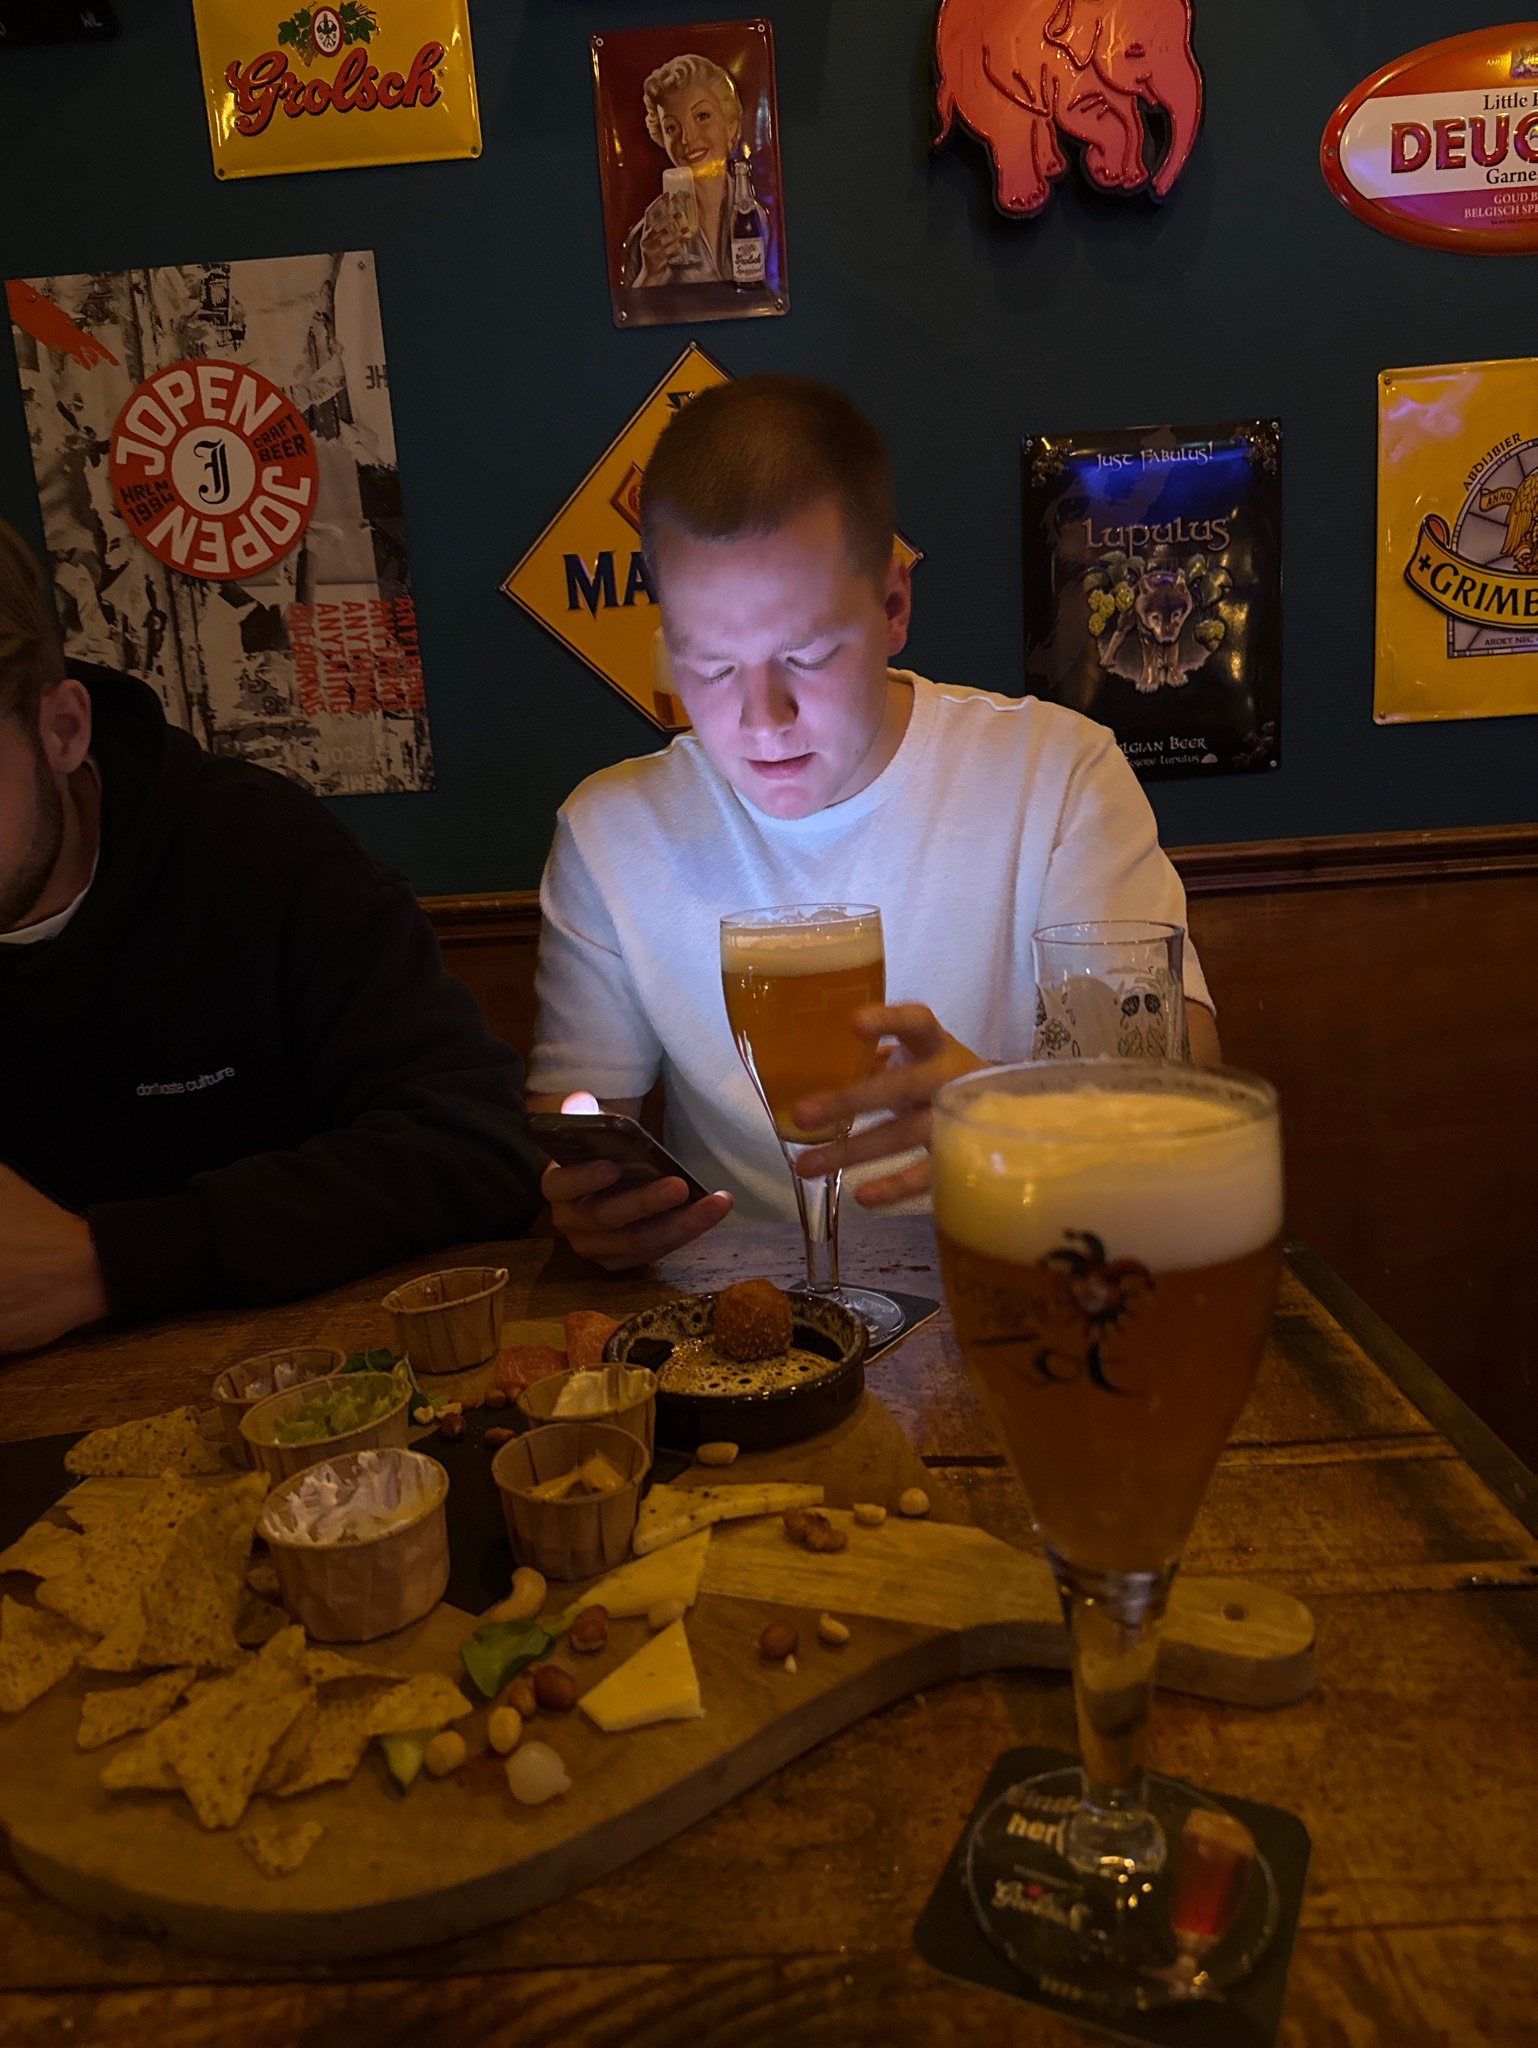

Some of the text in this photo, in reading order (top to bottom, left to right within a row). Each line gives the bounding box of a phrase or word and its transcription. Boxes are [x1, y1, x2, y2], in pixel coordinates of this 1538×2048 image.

[225, 41, 445, 136] Grolsch
[1483, 91, 1528, 110] Little
[1464, 204, 1520, 219] BELGISCH
[1494, 194, 1528, 204] GOUD
[116, 366, 283, 476] JOPEN
[252, 413, 299, 449] CRAFT
[258, 434, 309, 463] BEER
[1463, 432, 1522, 492] ABDIJBIER
[118, 479, 170, 506] HRLM
[1486, 491, 1512, 507] ANNO
[127, 492, 176, 526] 1994
[146, 466, 312, 574] JOPEN
[1485, 636, 1513, 646] ARDET
[316, 603, 354, 714] ANYTHING
[342, 601, 381, 714] ANYTHING
[185, 1066, 237, 1092] culture
